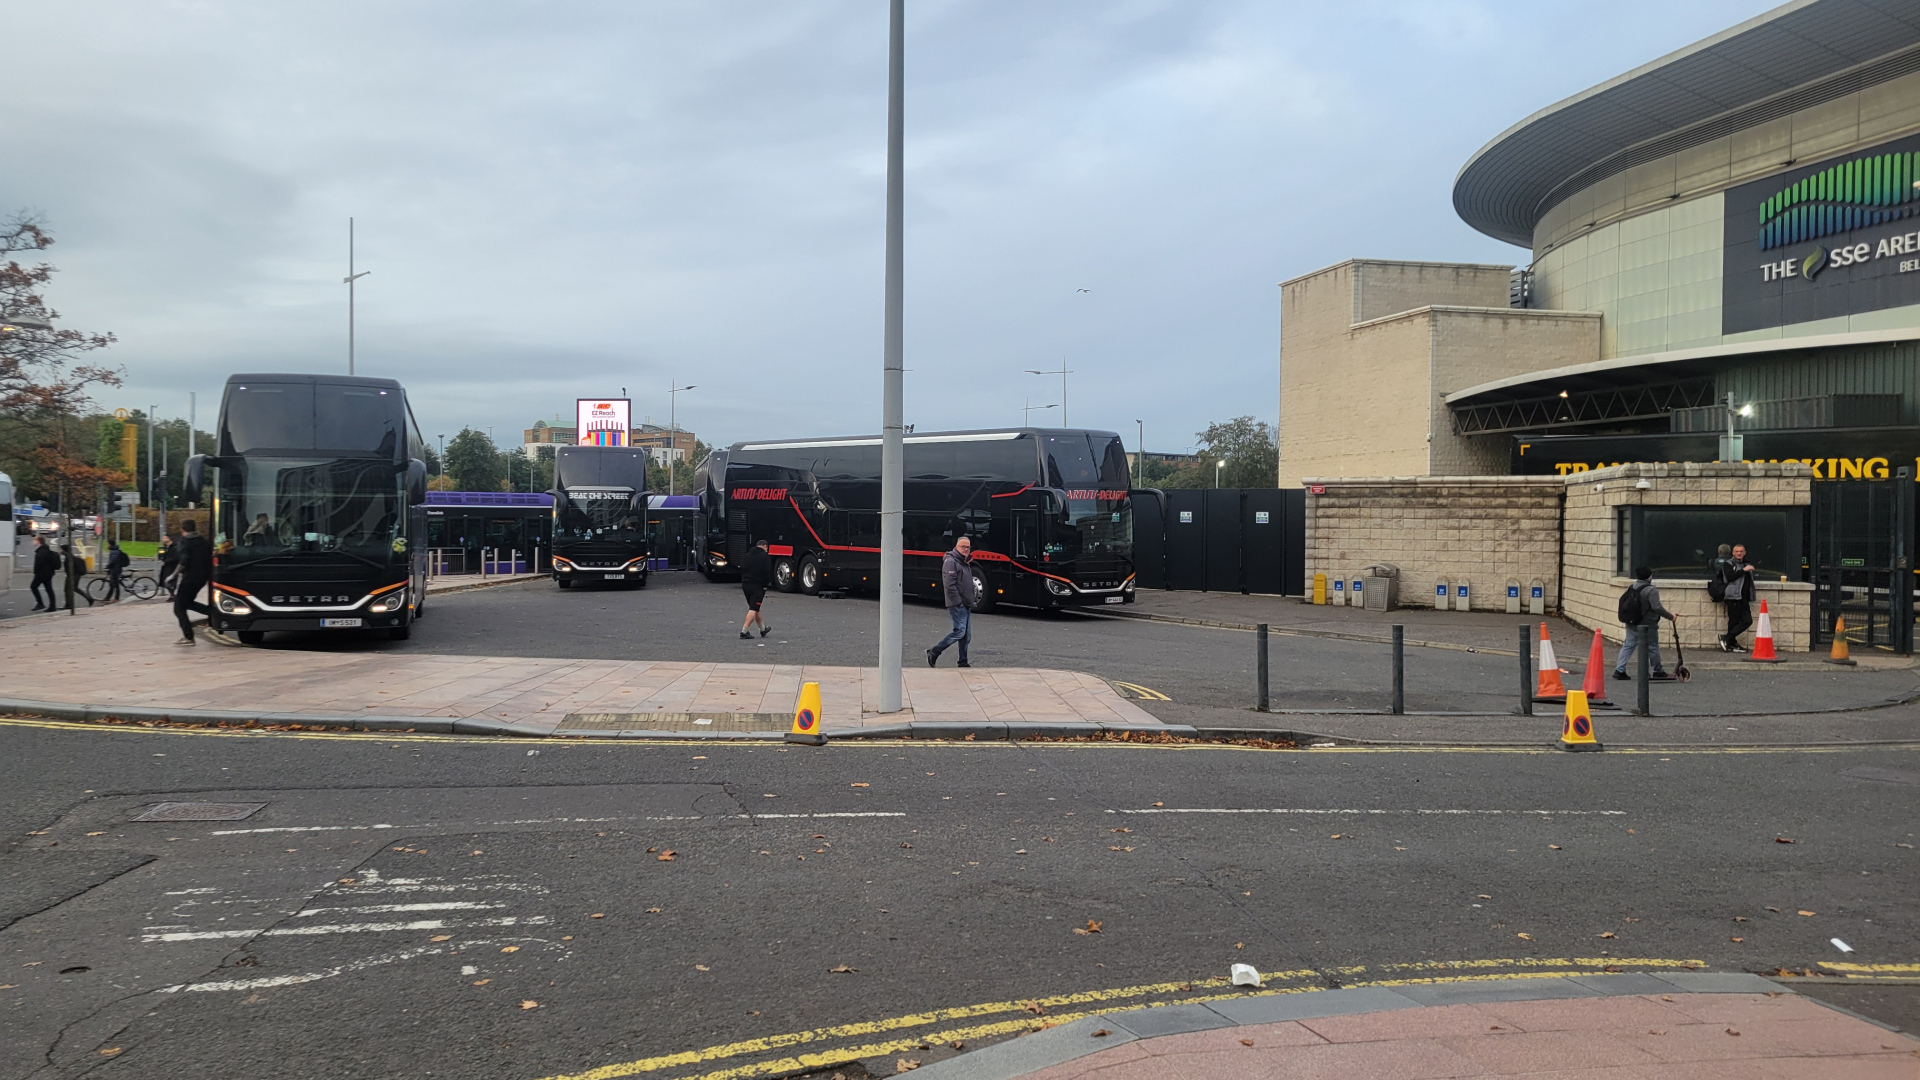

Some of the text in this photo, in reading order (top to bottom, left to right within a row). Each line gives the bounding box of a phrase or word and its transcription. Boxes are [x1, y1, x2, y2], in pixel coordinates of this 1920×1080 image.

[1760, 230, 1920, 282] THE sse ARE
[603, 492, 630, 500] STREET
[271, 595, 350, 603] SETRA
